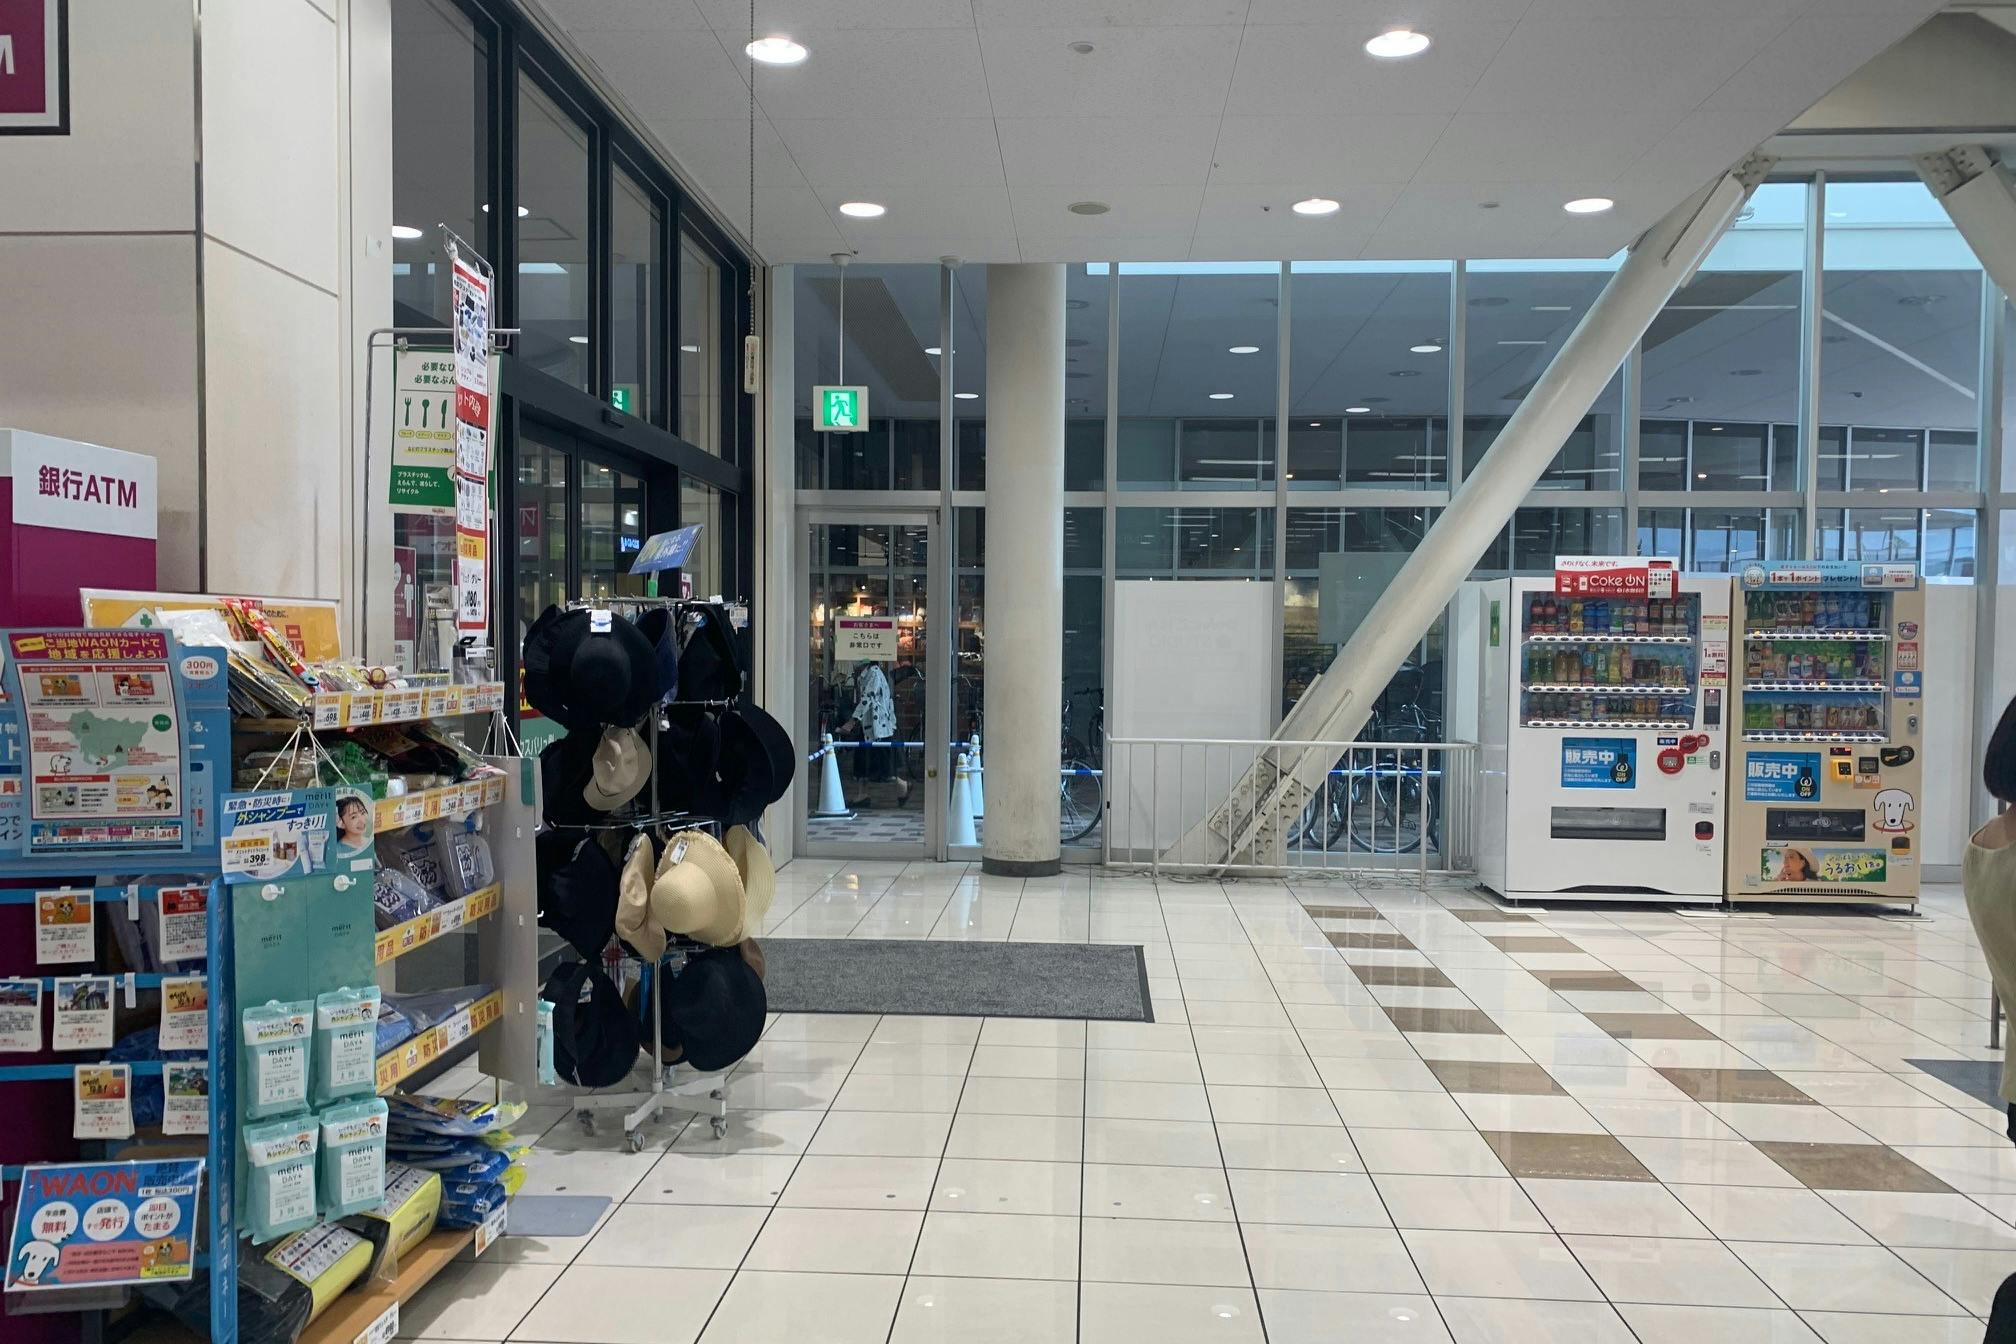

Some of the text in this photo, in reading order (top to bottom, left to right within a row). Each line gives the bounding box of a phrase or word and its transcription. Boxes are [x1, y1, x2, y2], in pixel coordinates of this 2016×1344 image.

[38, 464, 137, 508] 銀行ATM
[1589, 575, 1623, 587] Coke
[853, 632, 879, 640] こちらは
[45, 637, 160, 649] ご当地WAONカードで
[1565, 749, 1614, 765] 販売中
[1748, 761, 1798, 779] 販売中
[305, 792, 332, 801] merit
[236, 805, 303, 825] 外シャンプーで
[286, 816, 325, 832] すっきり!
[249, 853, 266, 863] 398
[261, 934, 282, 943] merit
[339, 1030, 364, 1039] merit
[268, 1045, 295, 1056] merit
[348, 1145, 373, 1157] merit
[277, 1163, 303, 1176] merit
[41, 1169, 138, 1198] WAON
[140, 1211, 173, 1221] ポイントが
[42, 1221, 67, 1234] 無料
